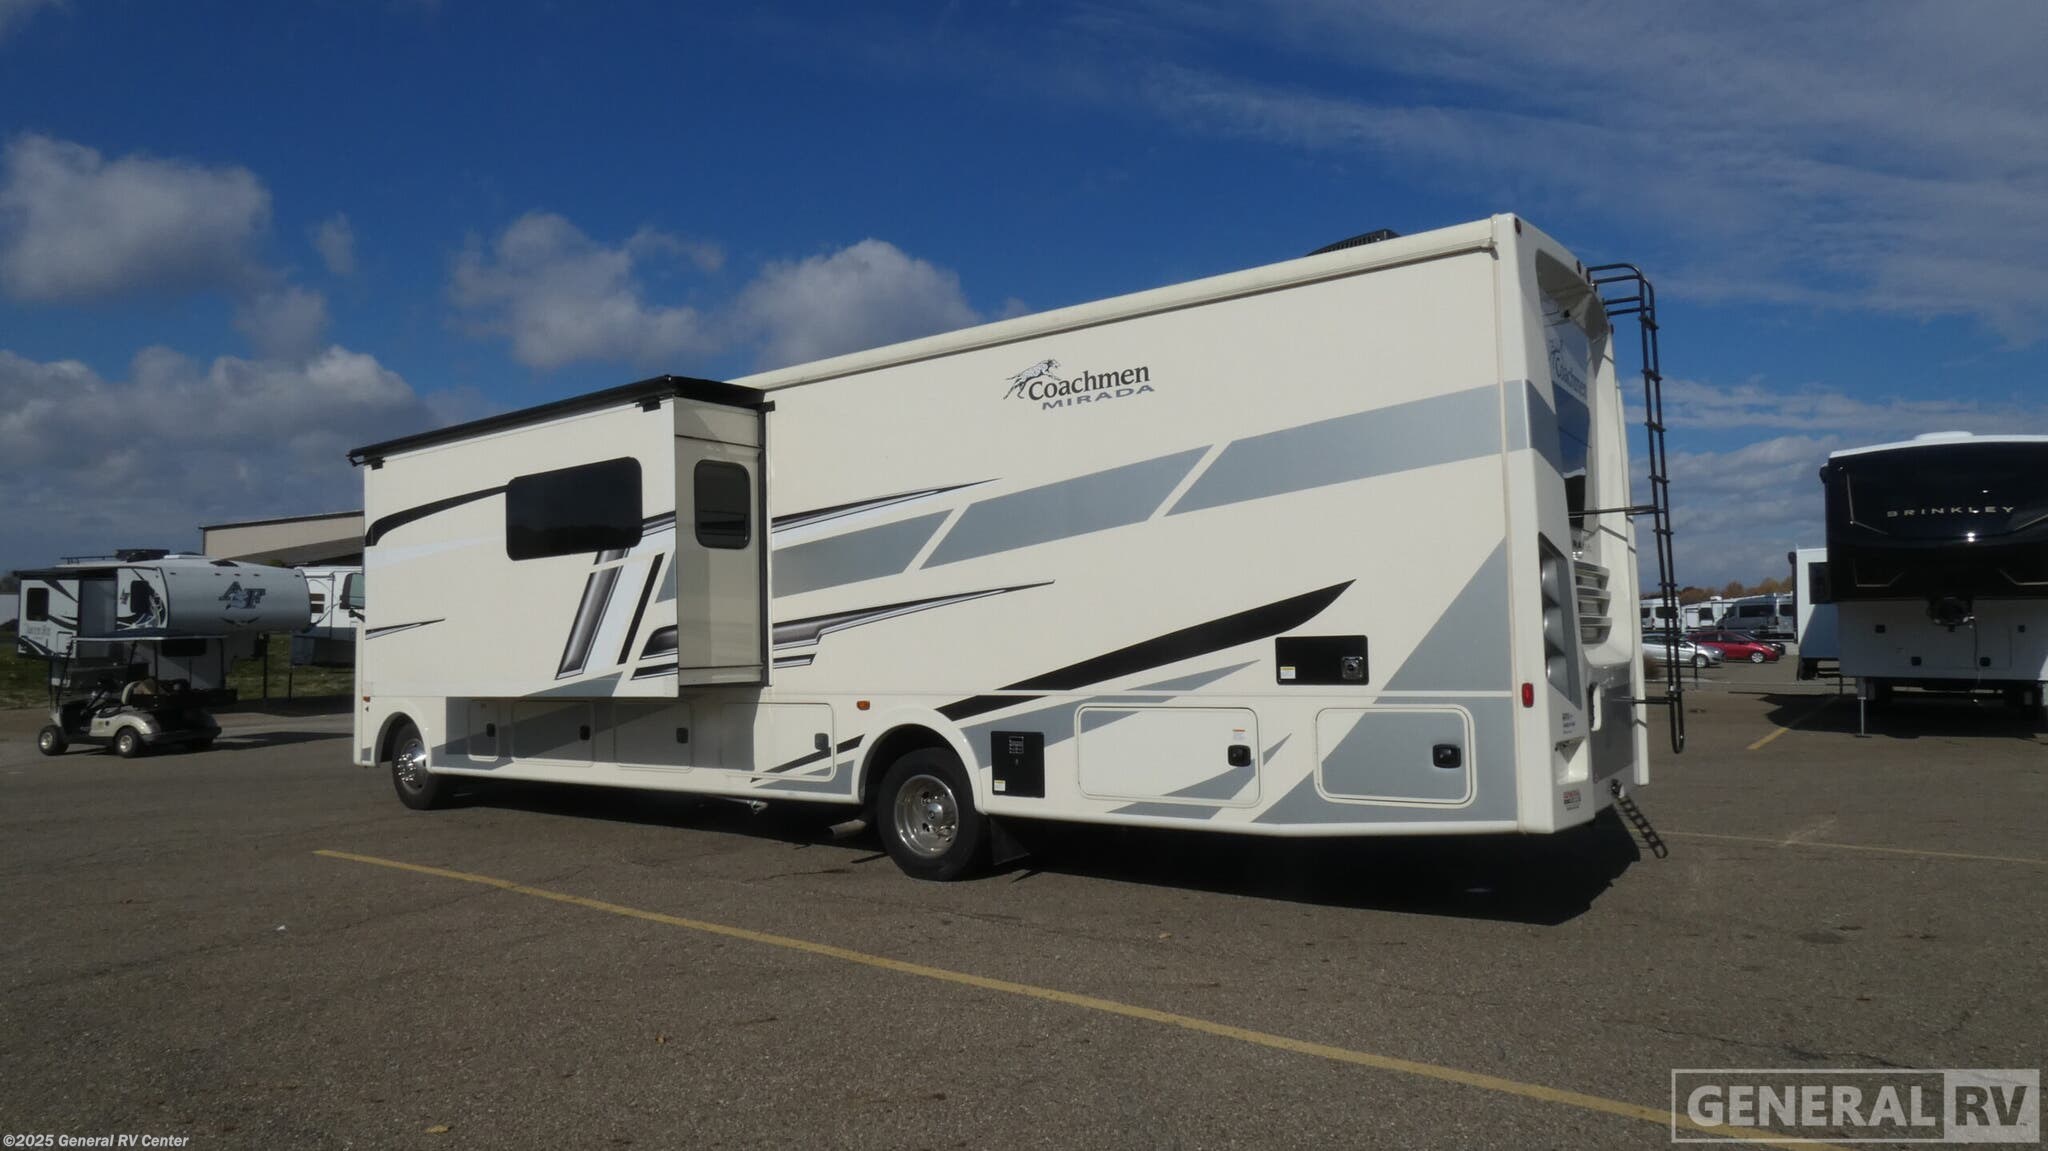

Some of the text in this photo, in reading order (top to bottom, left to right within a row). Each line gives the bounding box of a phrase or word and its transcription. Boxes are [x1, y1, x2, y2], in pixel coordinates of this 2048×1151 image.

[1028, 365, 1150, 401] Coachmen
[1042, 384, 1155, 411] MIRADA
[1886, 506, 2014, 518] BRINKLEY
